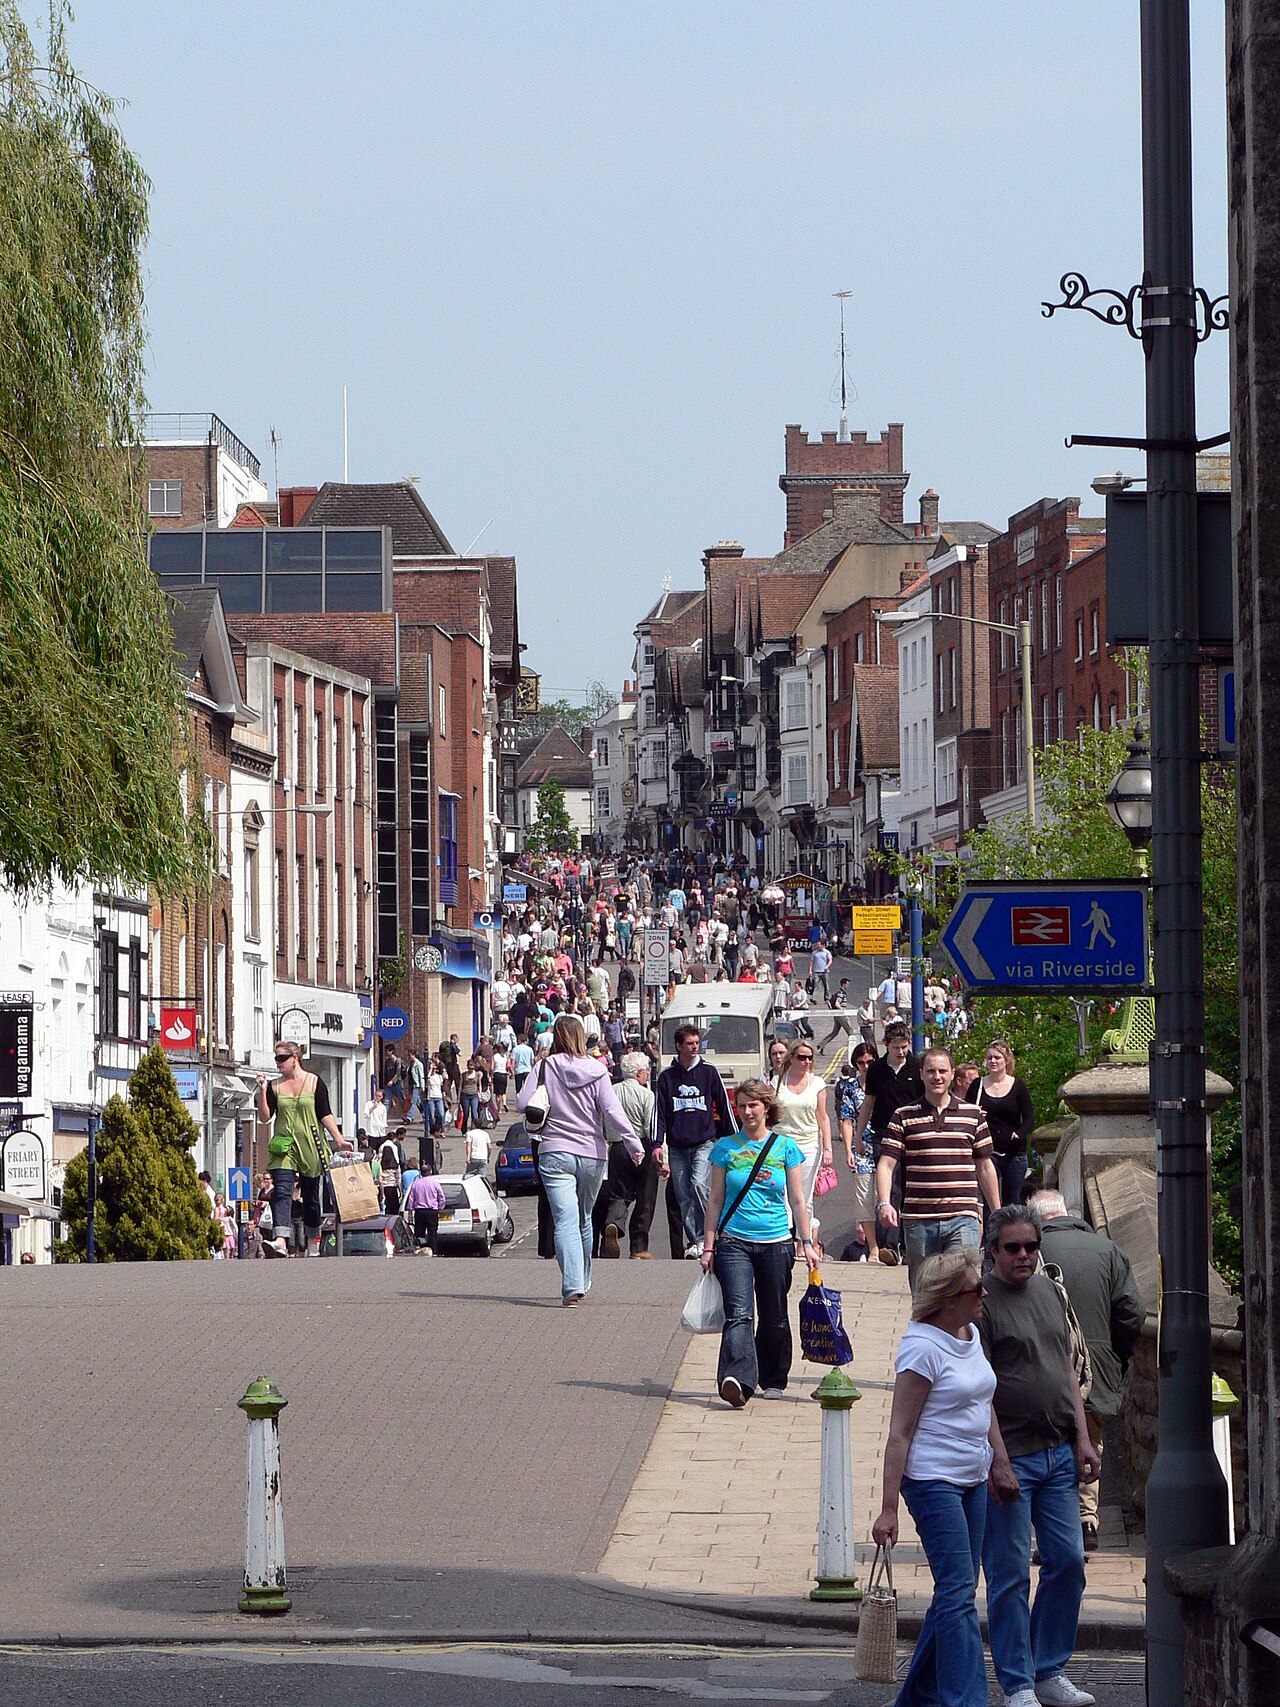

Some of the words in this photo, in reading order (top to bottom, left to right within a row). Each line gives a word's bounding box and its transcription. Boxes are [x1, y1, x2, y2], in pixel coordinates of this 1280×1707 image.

[1006, 961, 1034, 978] via
[1042, 960, 1136, 978] Riverside
[381, 1018, 404, 1027] REED
[17, 1016, 31, 1094] wagamama
[7, 1150, 39, 1162] FRIARY
[7, 1166, 40, 1179] STREET
